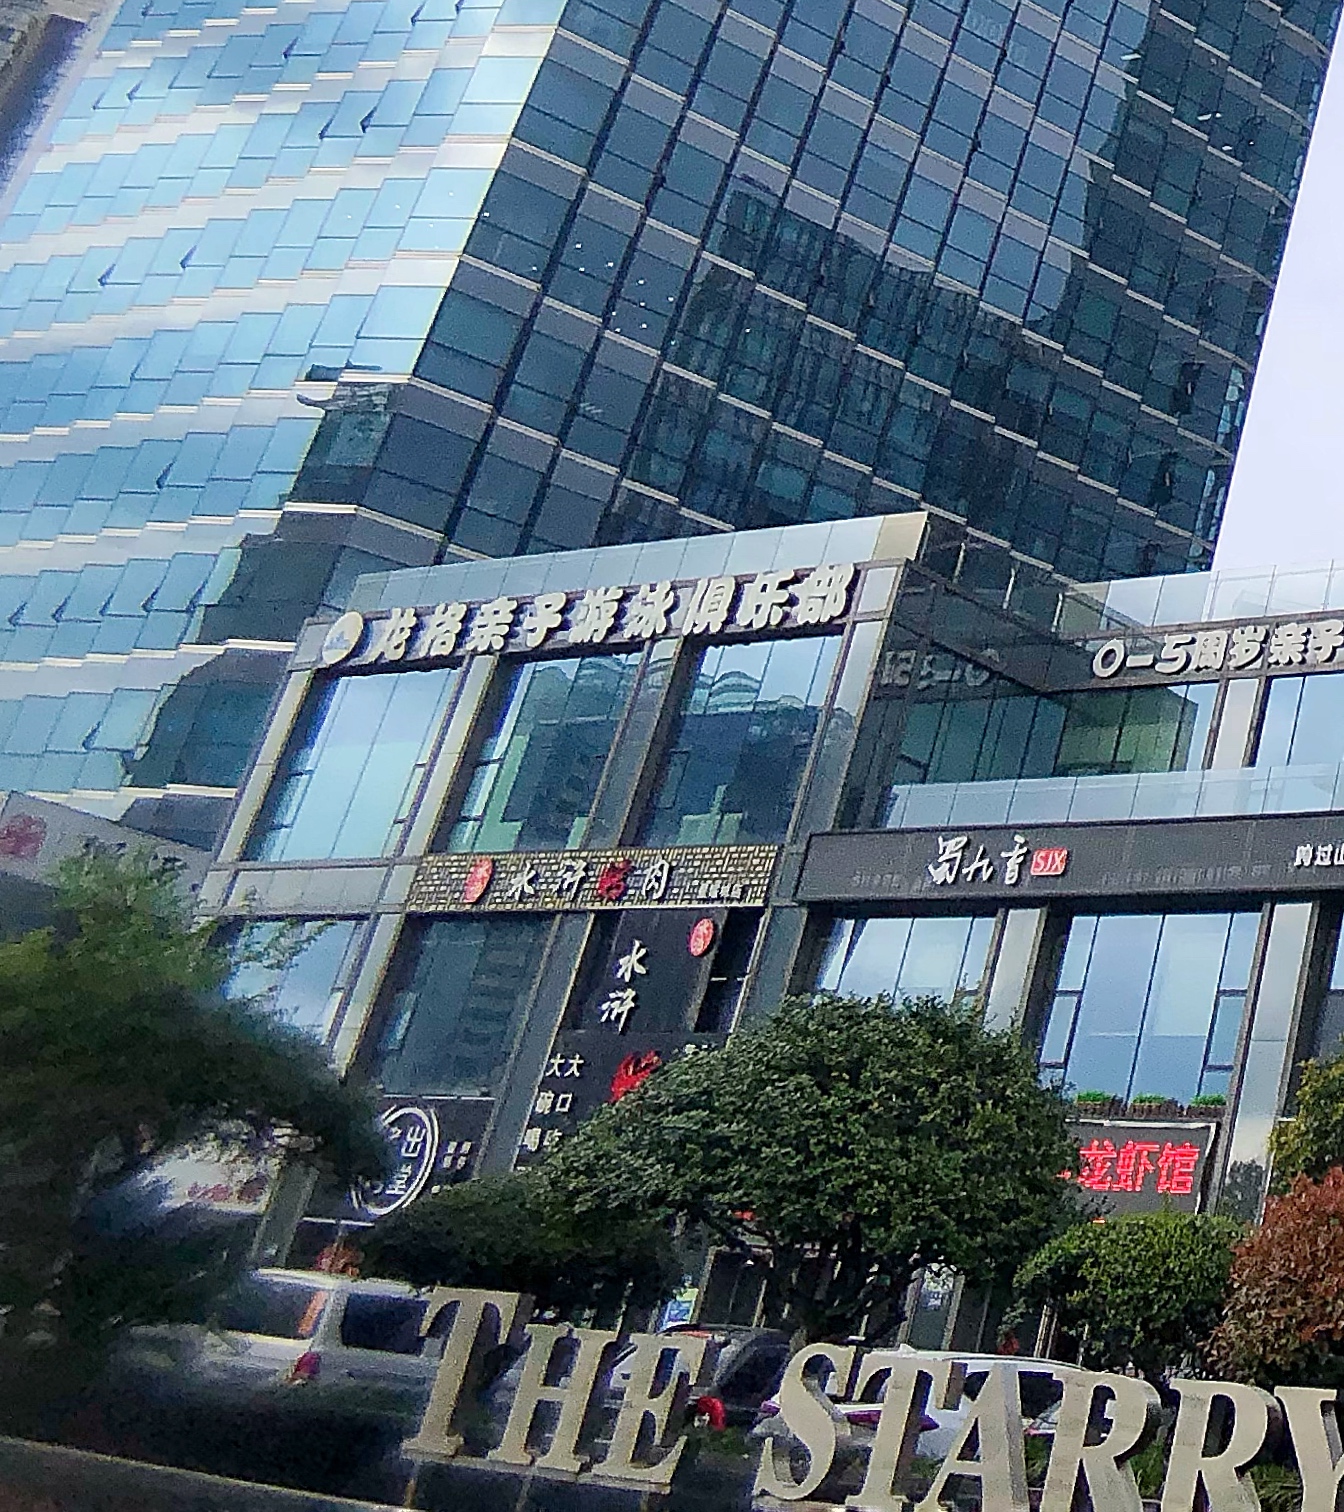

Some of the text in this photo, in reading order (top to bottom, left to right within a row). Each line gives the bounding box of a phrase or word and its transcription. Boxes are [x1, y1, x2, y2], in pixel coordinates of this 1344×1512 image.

[368, 563, 859, 662] 龙格亲子游泳俱乐部
[1057, 1138, 1200, 1195] 龙虾馆
[402, 1288, 718, 1493] THE
